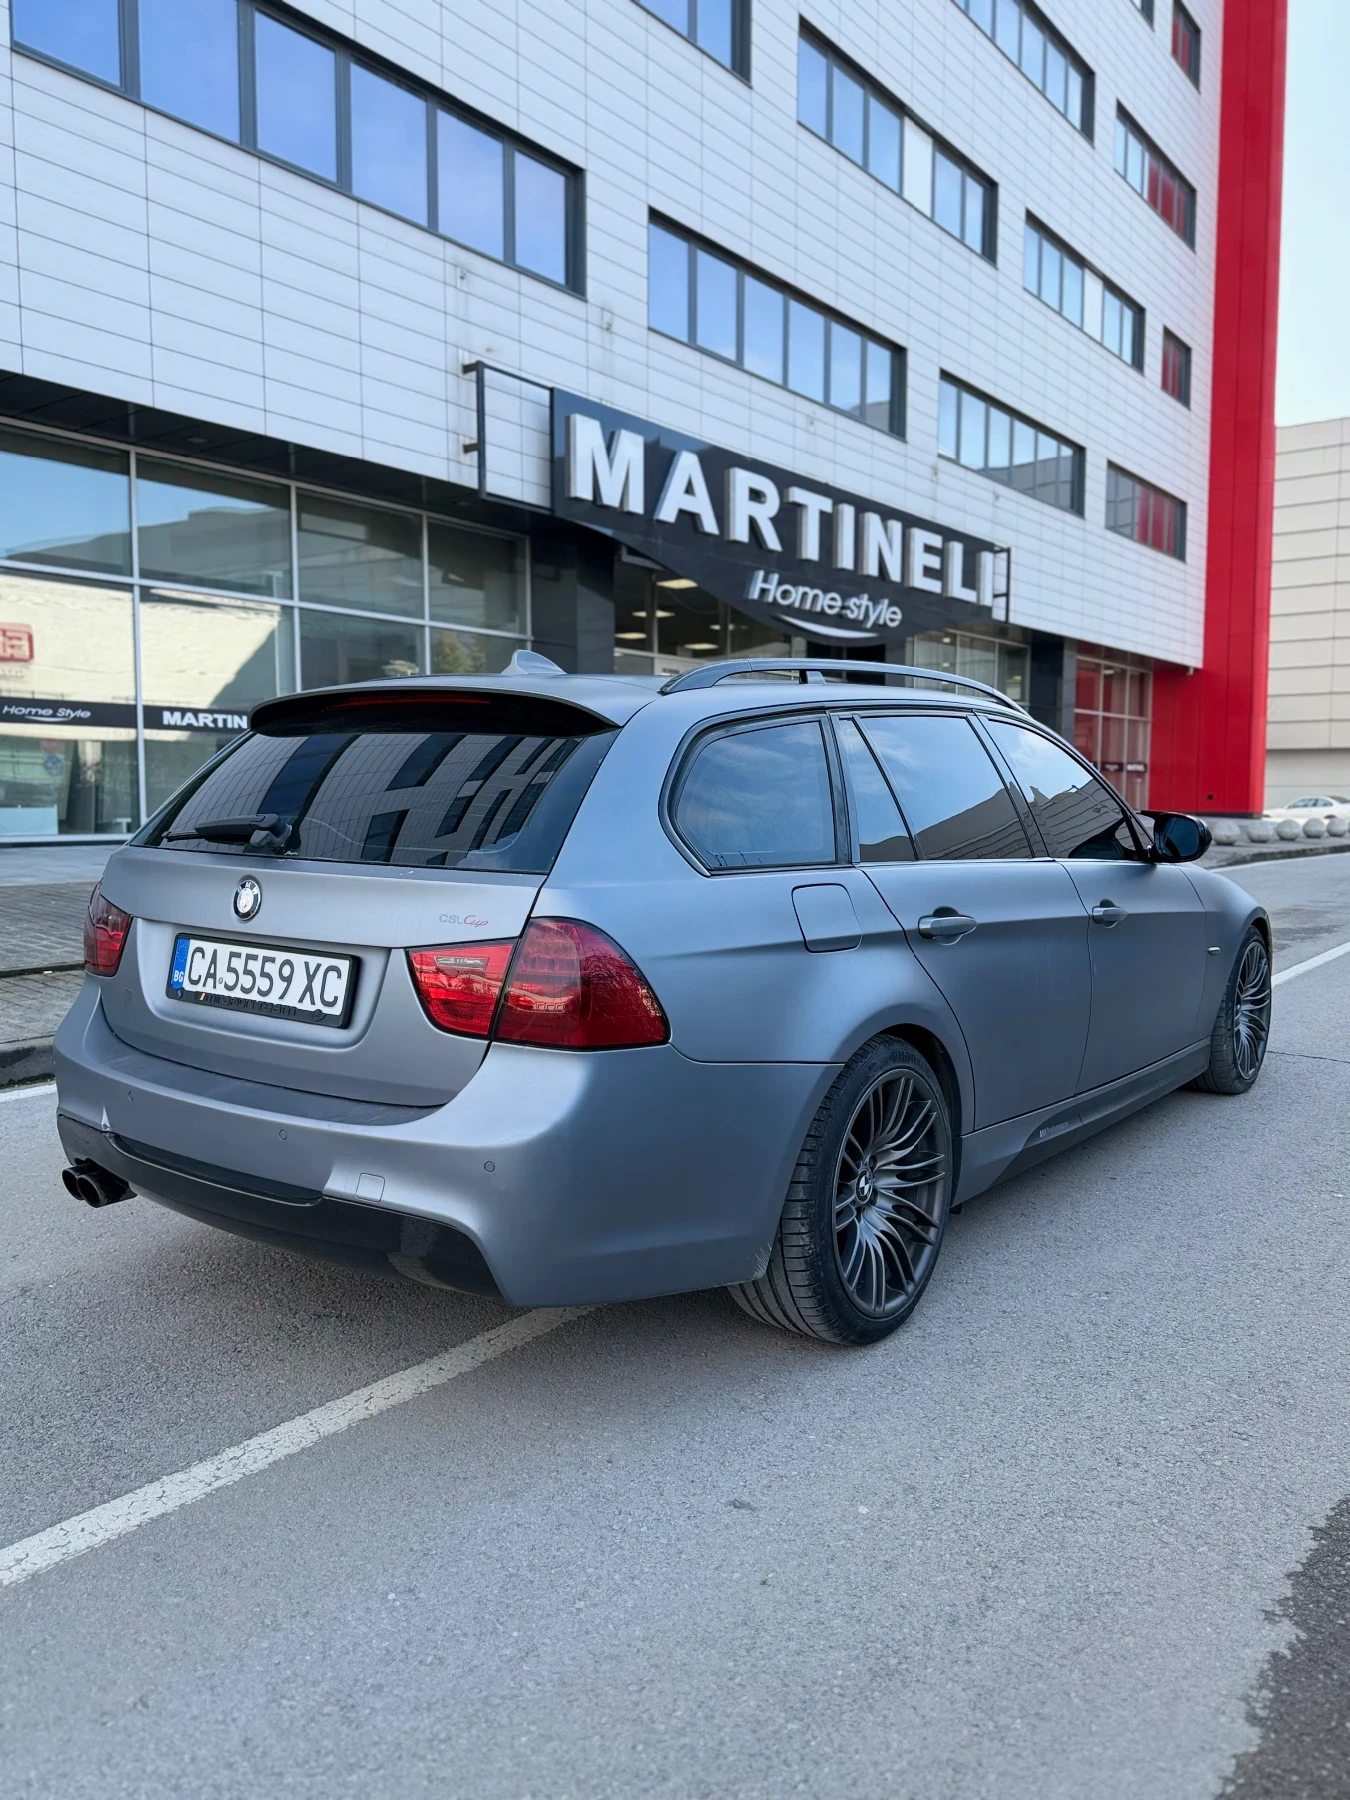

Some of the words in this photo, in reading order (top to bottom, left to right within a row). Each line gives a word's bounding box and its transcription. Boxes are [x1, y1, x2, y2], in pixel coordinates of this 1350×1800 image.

[566, 412, 994, 608] MARTINELI
[746, 569, 842, 615] Home
[845, 592, 902, 629] style
[2, 704, 51, 717] Home
[56, 707, 91, 719] Style
[162, 710, 248, 729] MARTIN
[173, 970, 185, 983] BG
[223, 950, 295, 1000] 5559
